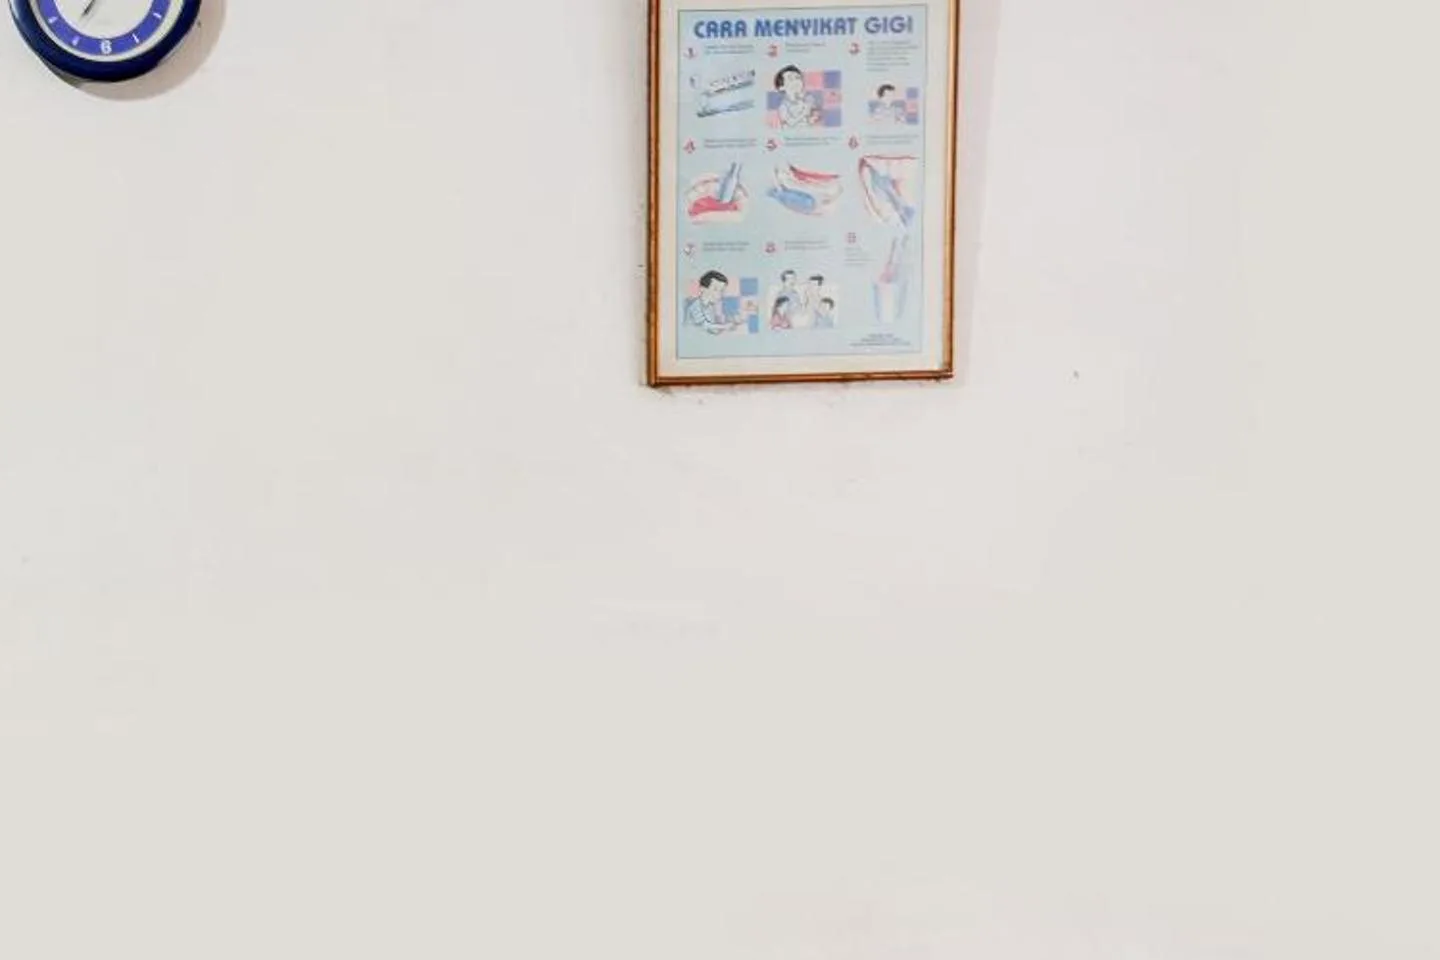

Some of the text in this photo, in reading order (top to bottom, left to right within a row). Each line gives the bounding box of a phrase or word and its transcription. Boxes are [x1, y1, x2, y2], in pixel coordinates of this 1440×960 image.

[694, 15, 914, 39] CARA MENYIKAT GIGI
[100, 39, 112, 54] 6
